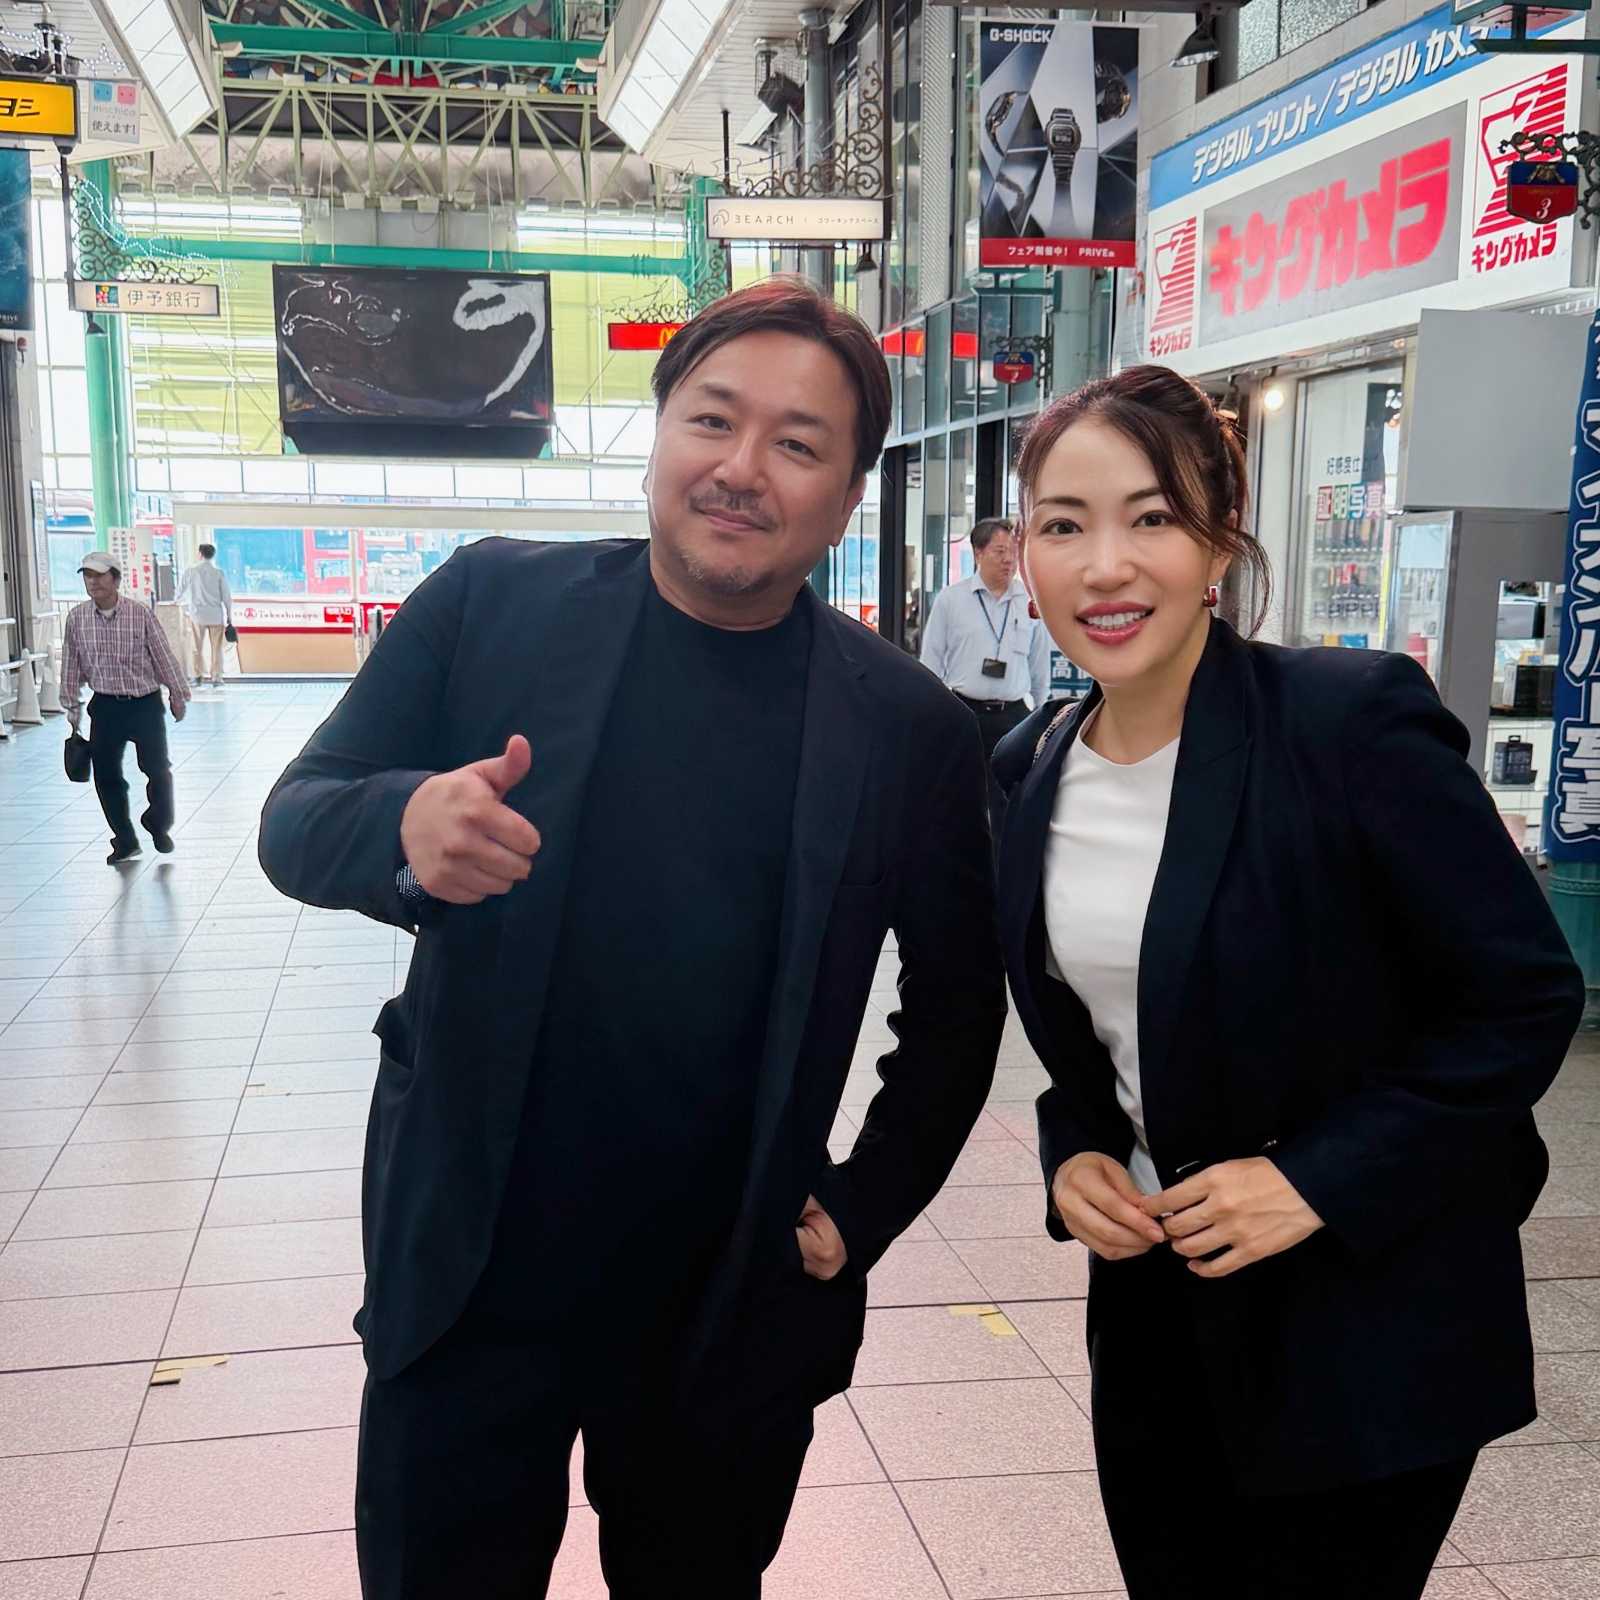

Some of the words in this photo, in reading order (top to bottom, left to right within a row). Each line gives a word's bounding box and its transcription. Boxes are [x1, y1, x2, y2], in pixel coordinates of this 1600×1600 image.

[989, 28, 1051, 43] G-SHOCK
[1536, 198, 1552, 219] 3
[1208, 136, 1451, 318] キングカメラ
[1472, 223, 1558, 273] キングカメラ
[127, 289, 201, 309] 伊予銀行
[1150, 327, 1192, 358] キングカメラ
